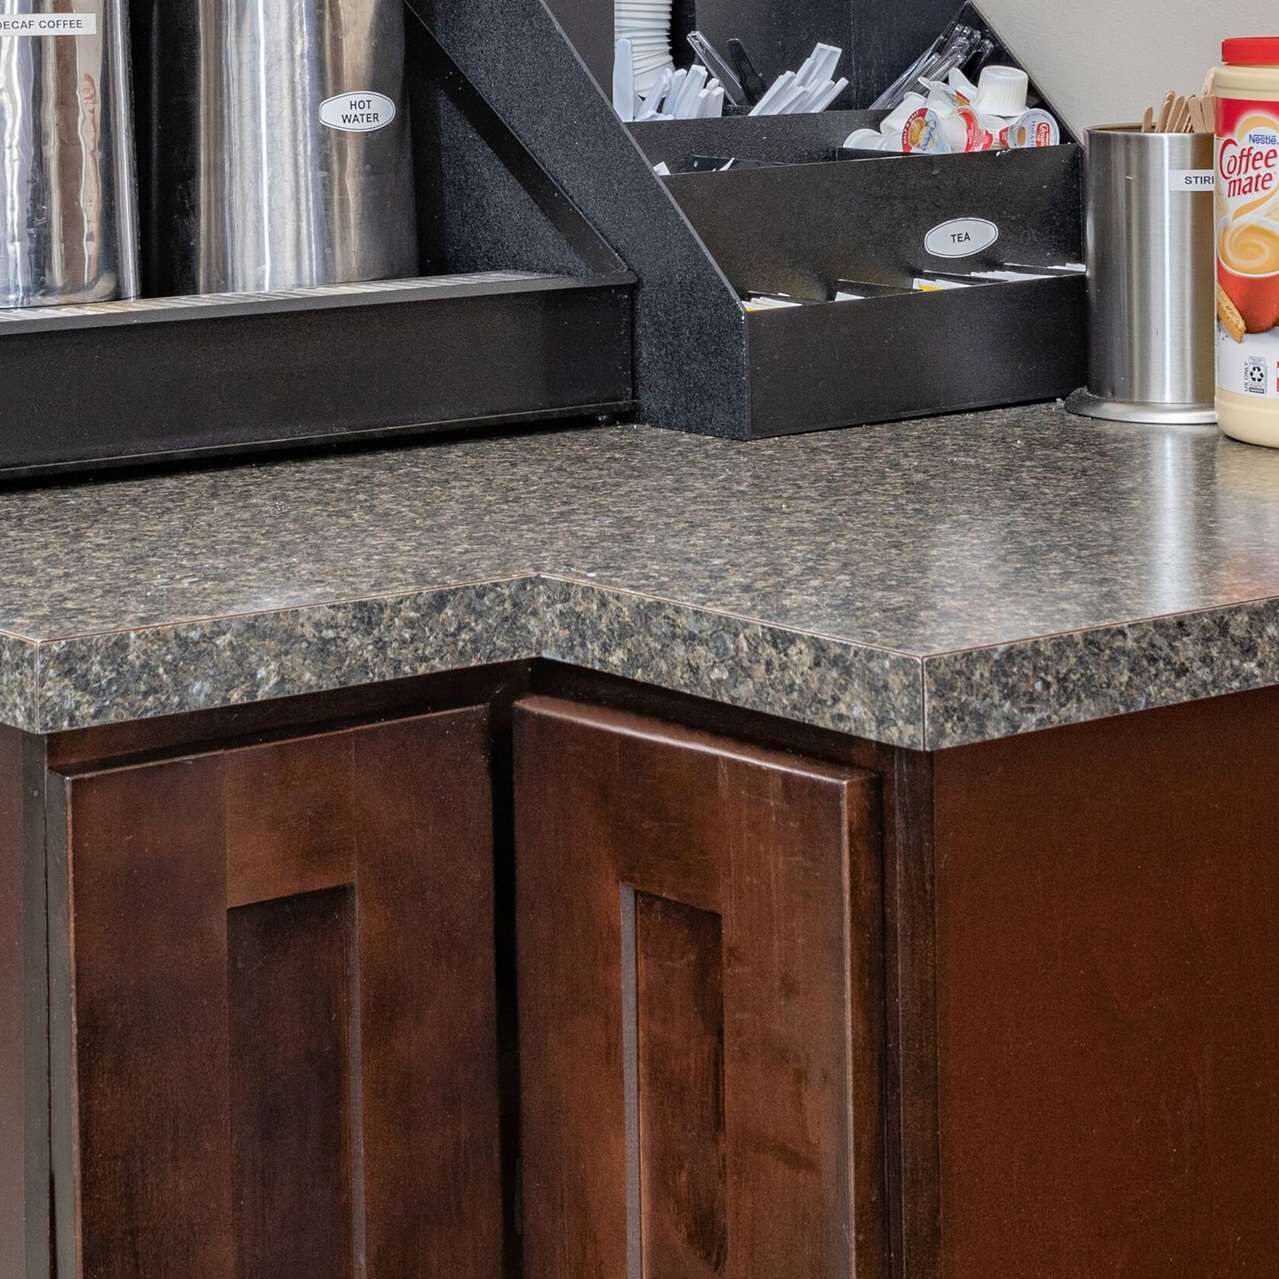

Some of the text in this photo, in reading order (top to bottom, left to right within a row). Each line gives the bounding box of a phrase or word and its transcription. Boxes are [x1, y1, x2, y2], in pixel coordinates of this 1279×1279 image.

[39, 19, 83, 29] COFFEE
[350, 100, 372, 110] HOT
[342, 113, 379, 124] WATER
[1219, 138, 1277, 180] Coffee
[1184, 176, 1214, 184] STIR
[1227, 172, 1273, 198] mate
[950, 232, 971, 243] TEA
